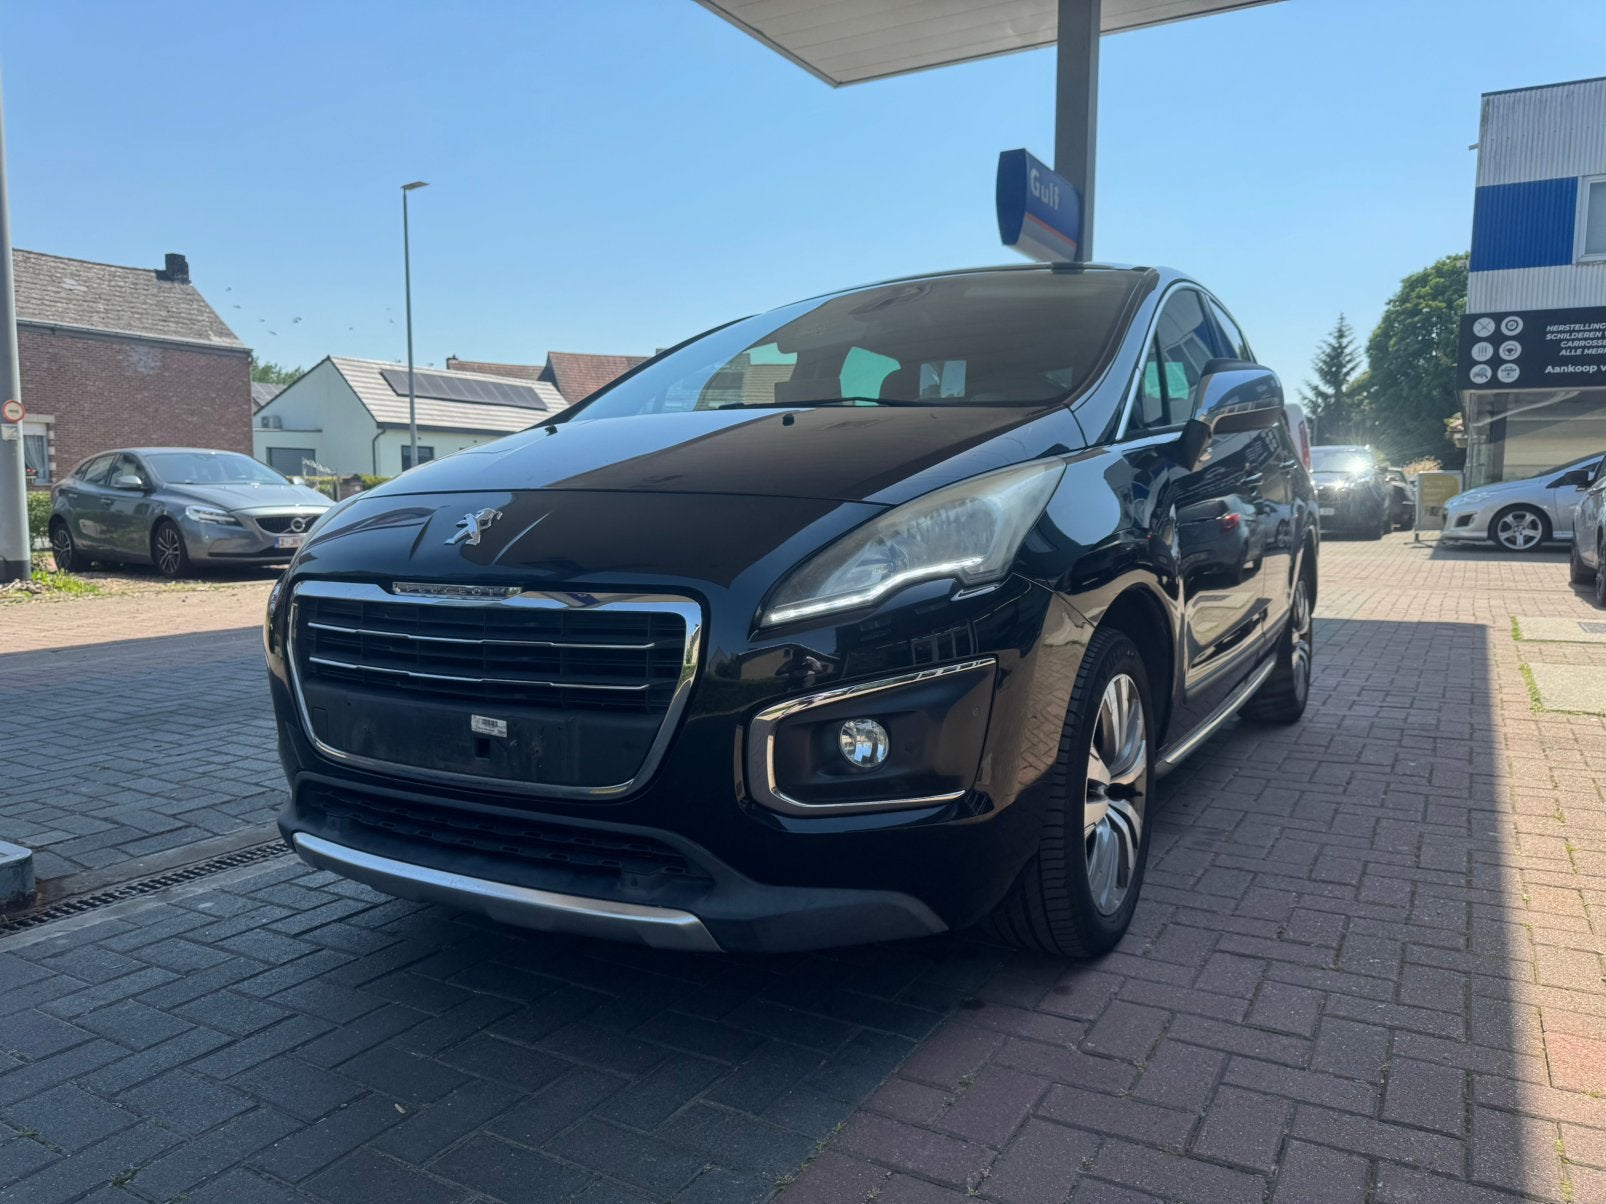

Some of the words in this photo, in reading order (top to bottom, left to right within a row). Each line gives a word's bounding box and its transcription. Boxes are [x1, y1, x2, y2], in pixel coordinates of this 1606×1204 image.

[1030, 168, 1059, 211] Gulf
[1545, 331, 1603, 340] SCHILDEREN
[1559, 348, 1582, 356] ALLE
[1544, 364, 1598, 374] Aankoop
